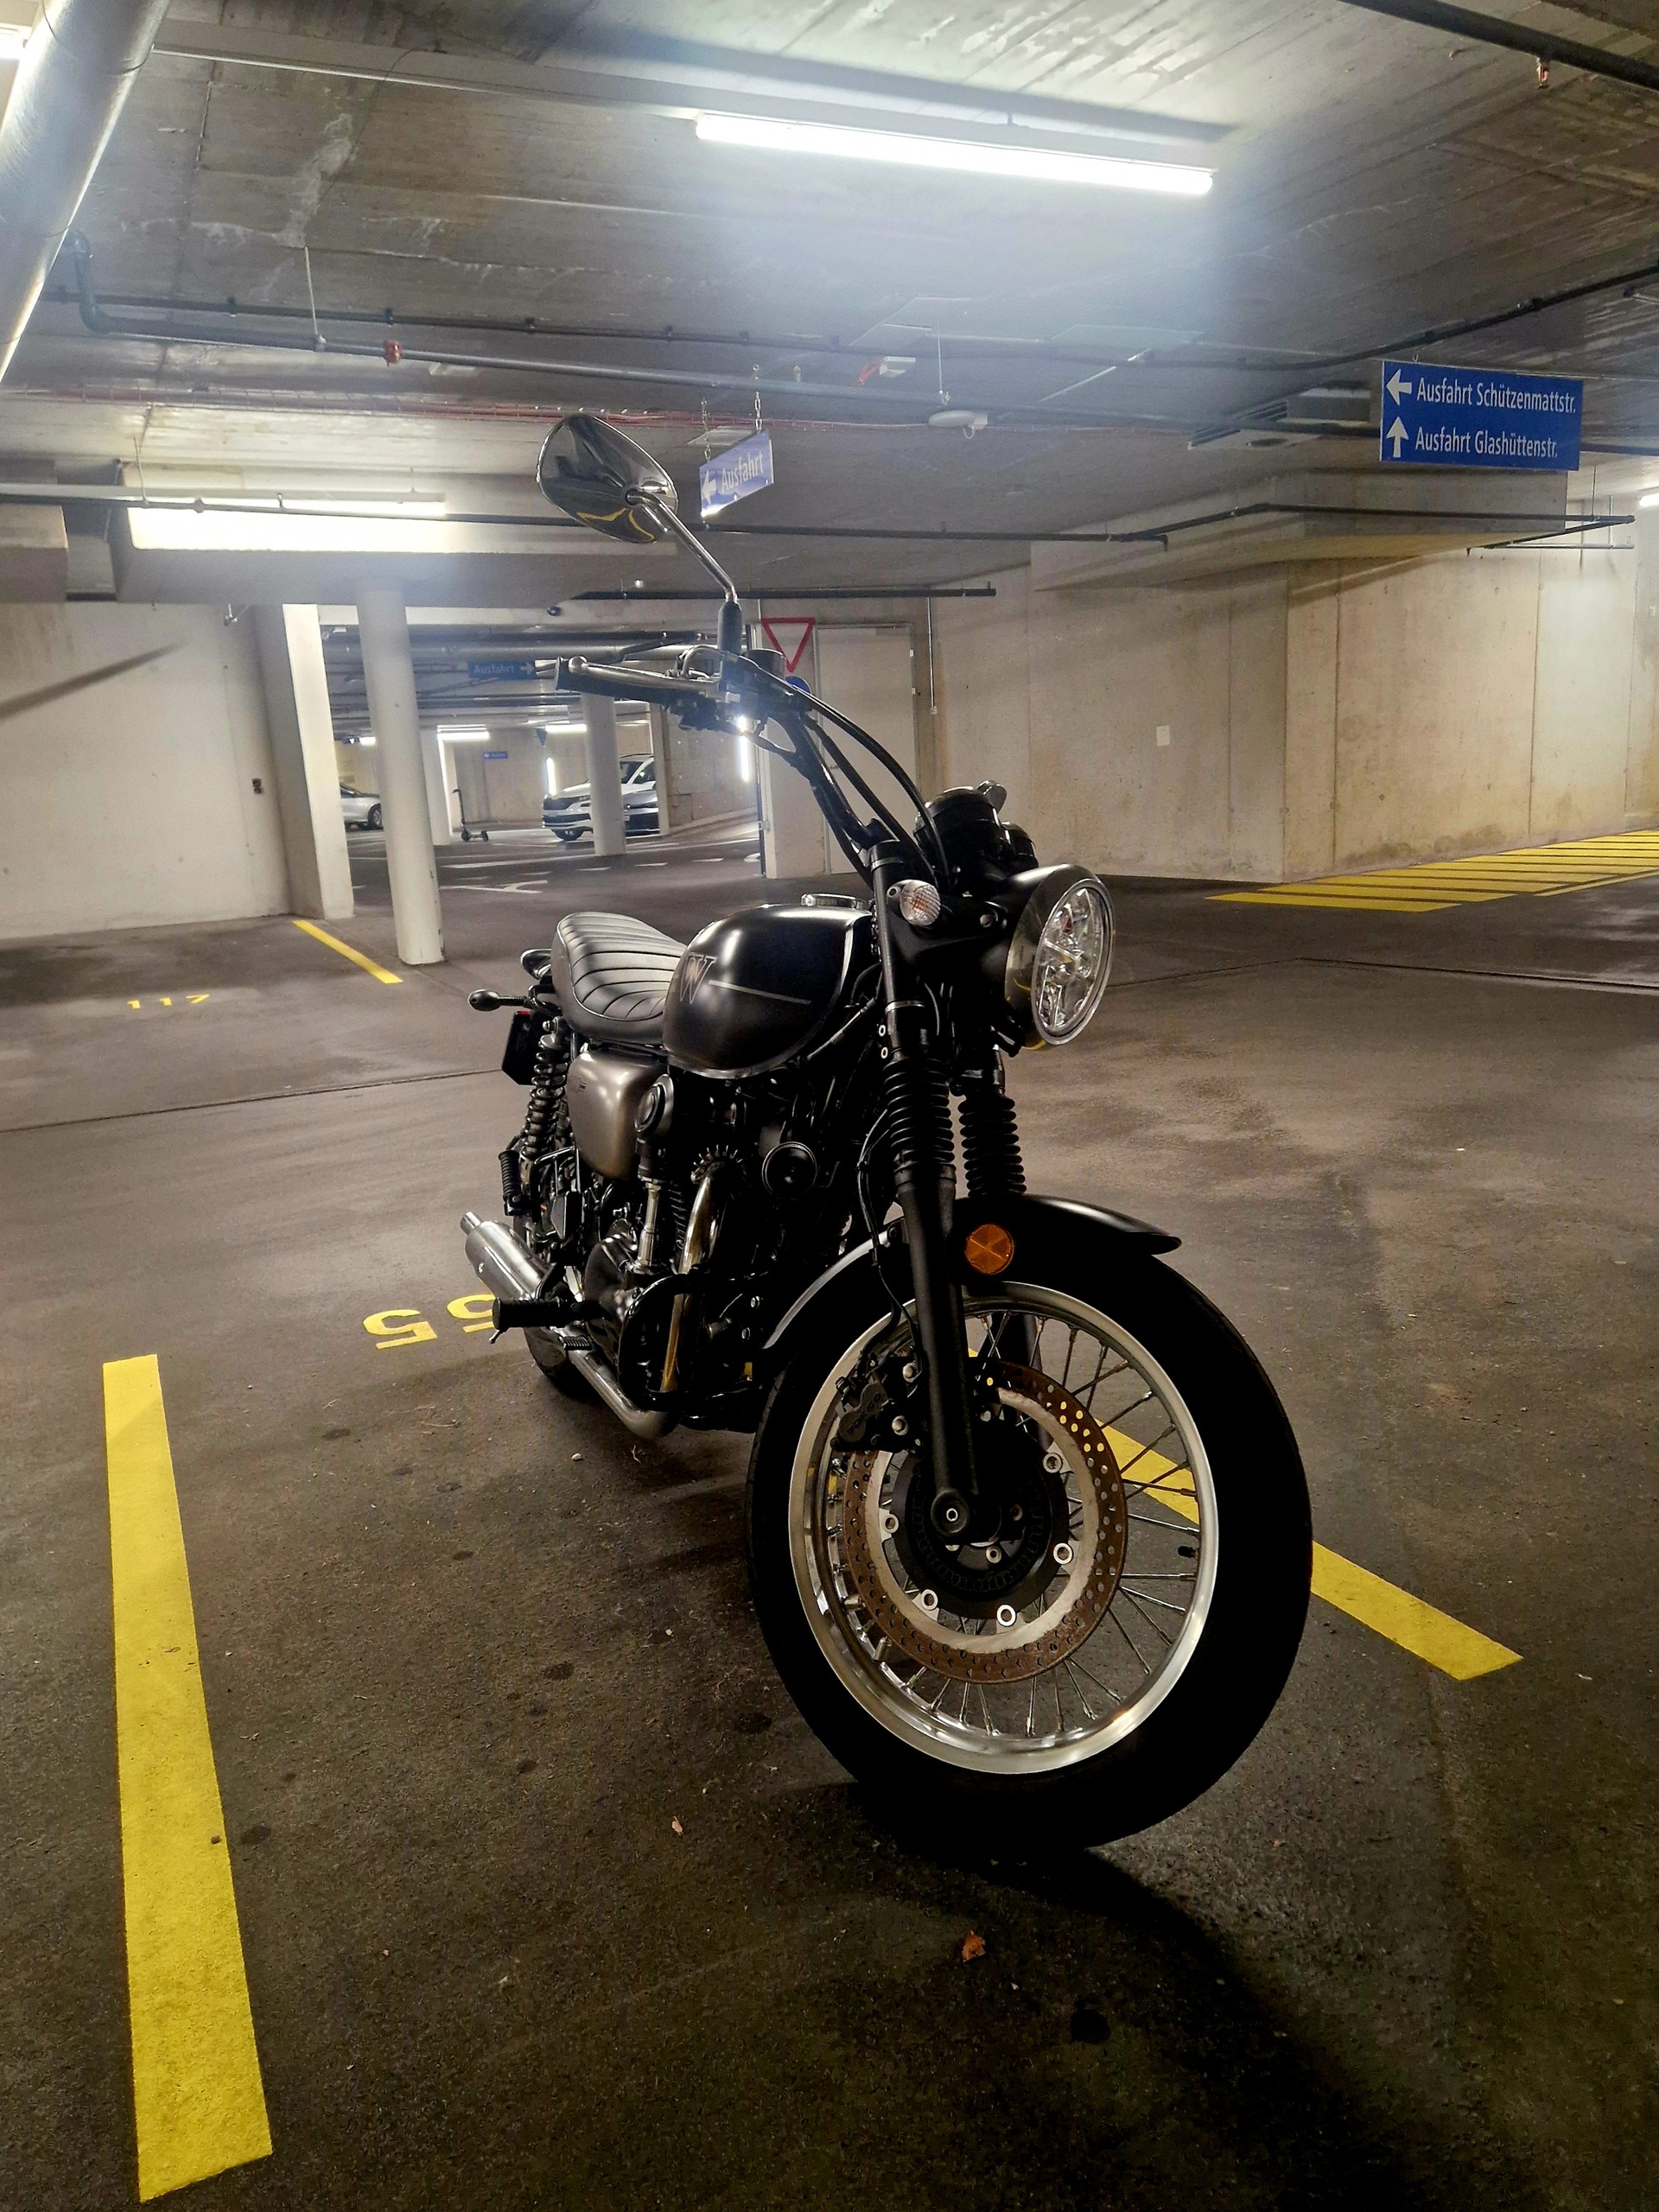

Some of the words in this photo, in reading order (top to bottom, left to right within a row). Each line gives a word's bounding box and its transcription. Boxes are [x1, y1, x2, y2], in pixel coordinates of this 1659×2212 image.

[1416, 377, 1473, 405] Ausfahrt
[1476, 383, 1577, 414] Schützenmattstr.
[1415, 426, 1471, 452] Ausfahrt
[1474, 430, 1559, 458] Glashüttenstr.
[721, 450, 765, 493] Ausfahrt
[680, 951, 718, 1004] W
[126, 994, 211, 1009] 117
